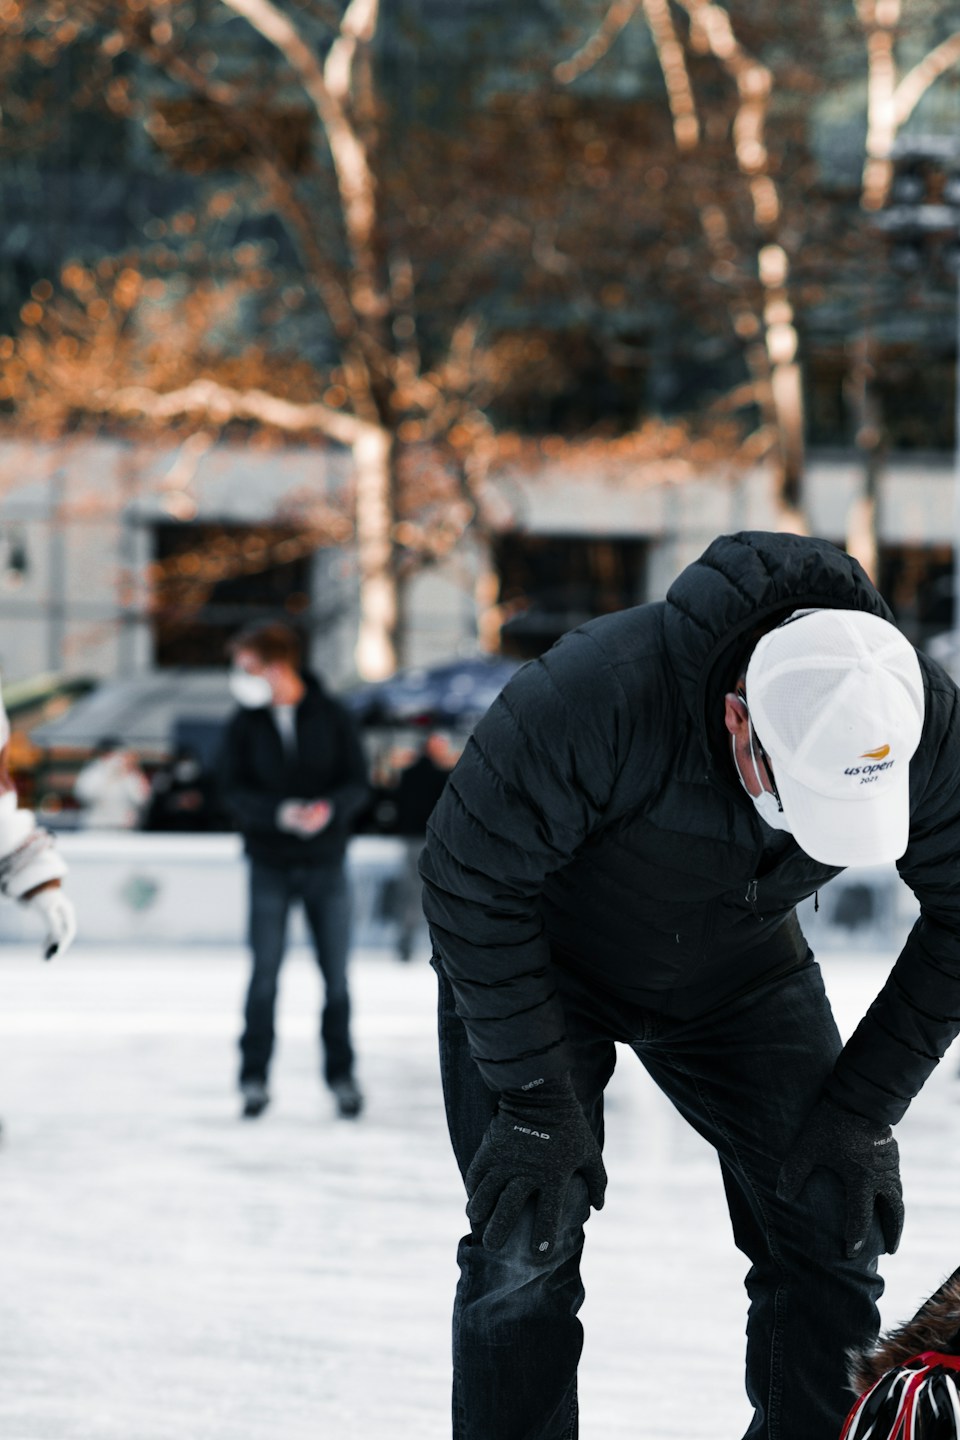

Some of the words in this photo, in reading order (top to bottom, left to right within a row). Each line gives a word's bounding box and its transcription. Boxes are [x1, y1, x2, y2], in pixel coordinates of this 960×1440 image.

[844, 766, 861, 776] us
[862, 760, 894, 775] open
[513, 1125, 551, 1140] HEAD
[874, 1136, 893, 1146] HEA
